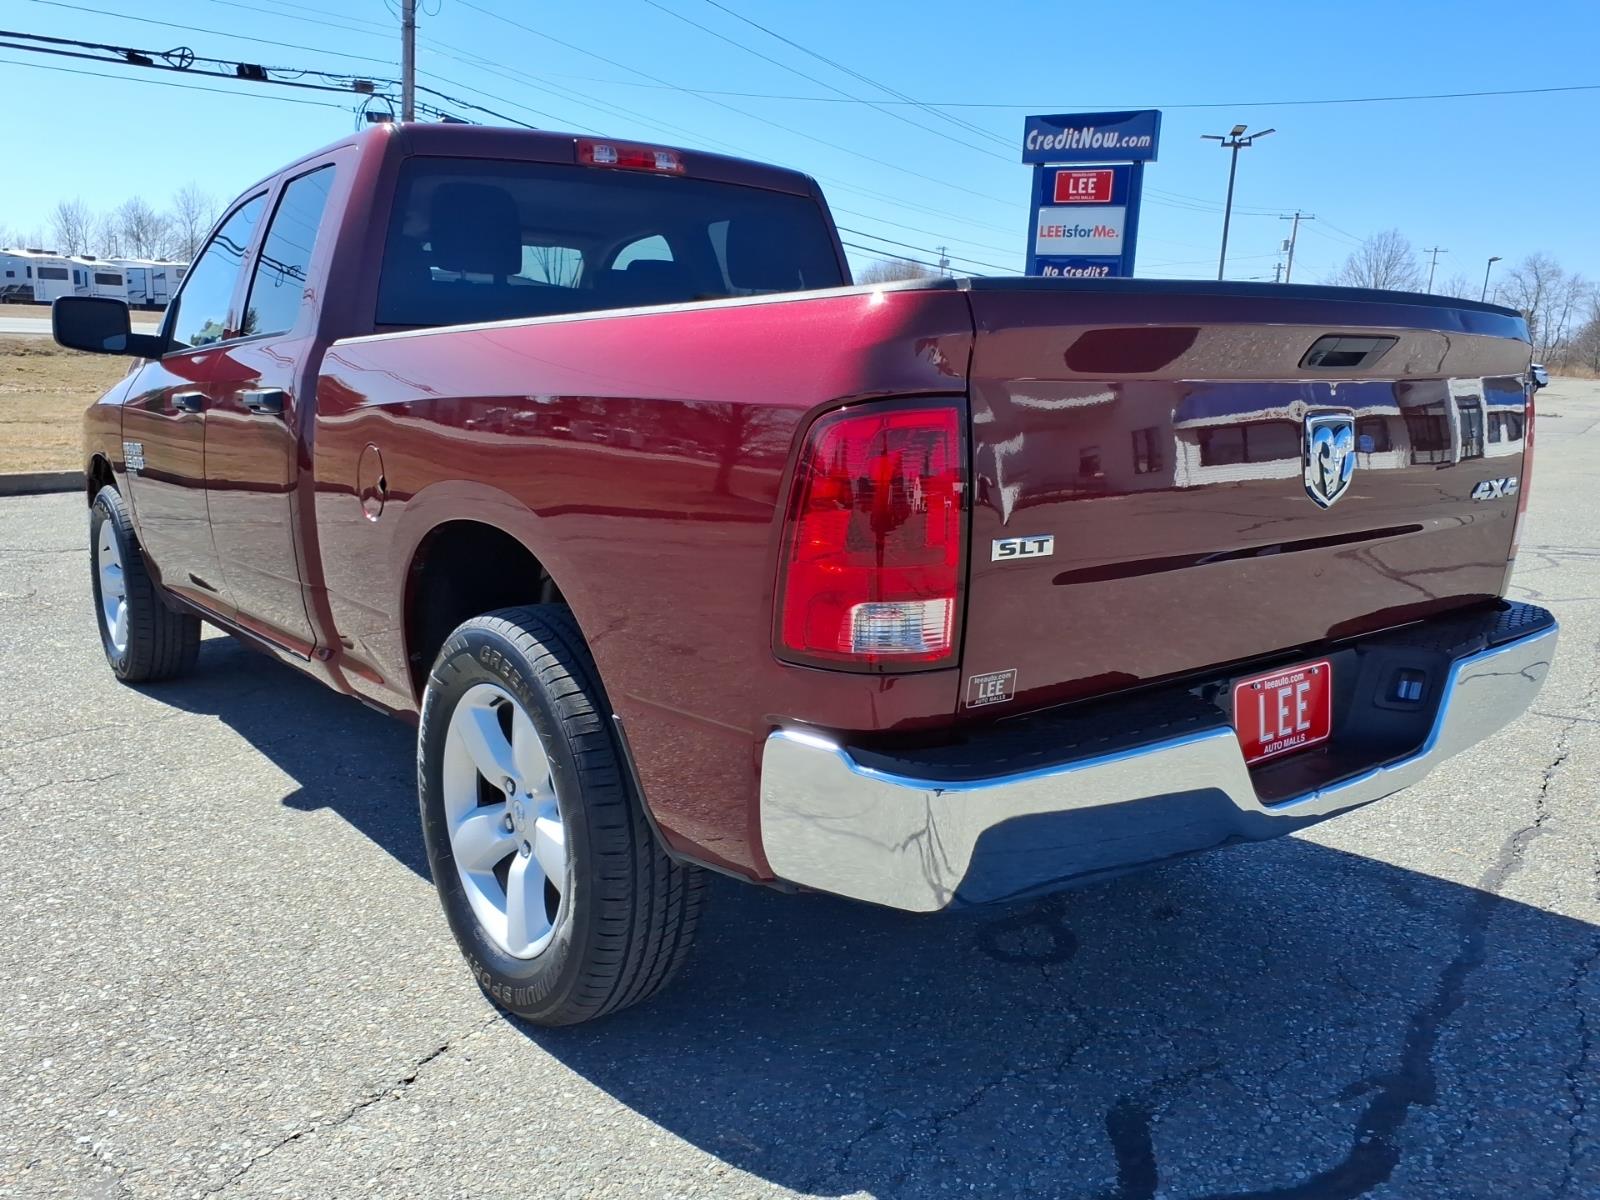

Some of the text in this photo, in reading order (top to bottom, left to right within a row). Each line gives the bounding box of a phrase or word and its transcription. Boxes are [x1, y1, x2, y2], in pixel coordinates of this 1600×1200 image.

[1026, 127, 1151, 150] CreditNow.com
[1069, 178, 1097, 194] LEE
[1039, 224, 1119, 238] LEEisforMe.
[1042, 266, 1109, 278] No Credit?
[998, 539, 1050, 557] SLT
[979, 680, 1005, 698] LEE
[1264, 674, 1305, 689] leeauto.com
[1259, 682, 1310, 743] LEE
[1263, 734, 1306, 753] AUTO MALLS
